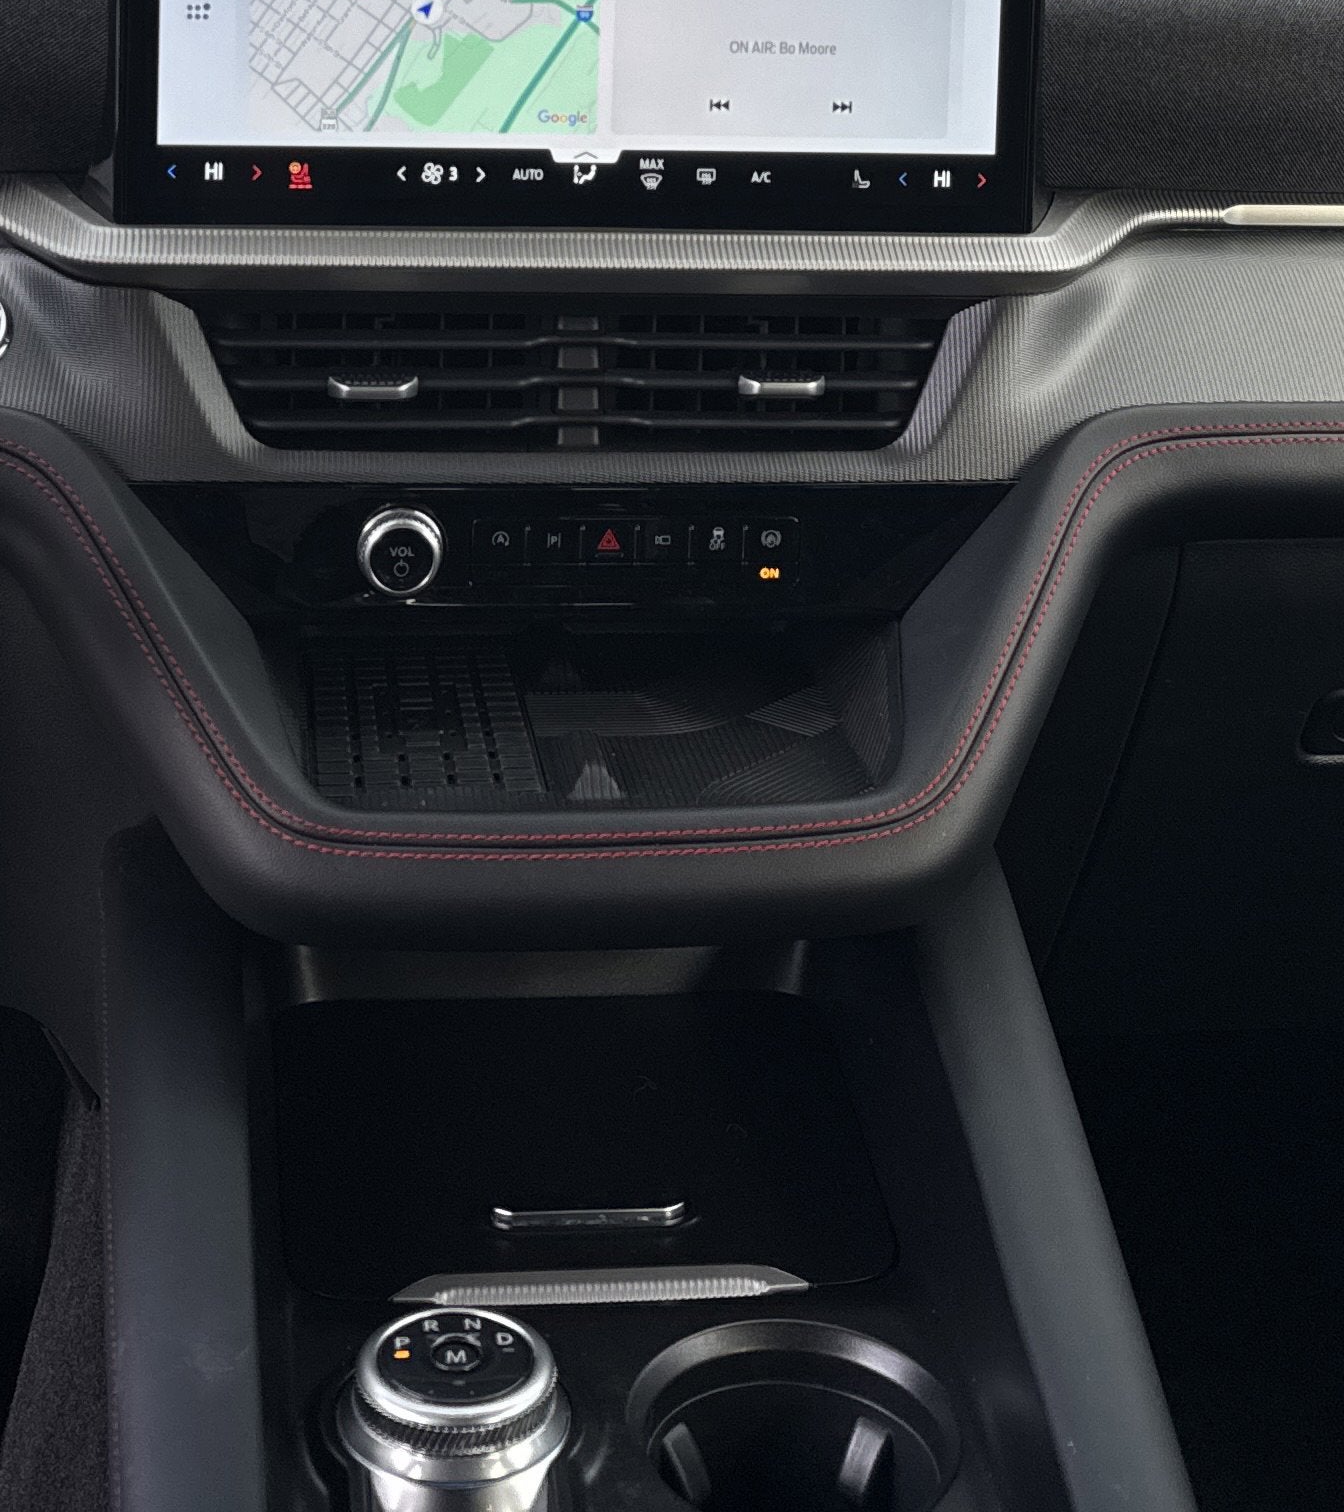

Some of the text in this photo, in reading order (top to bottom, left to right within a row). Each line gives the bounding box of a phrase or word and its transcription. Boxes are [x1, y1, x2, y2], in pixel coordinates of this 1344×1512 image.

[729, 40, 837, 56] ON AIR: Bo Moore
[537, 109, 588, 127] Google
[204, 162, 224, 181] HI
[638, 158, 665, 171] MAX
[448, 166, 458, 182] 3
[512, 167, 545, 183] AUTO
[750, 169, 772, 185] A/C
[932, 169, 952, 188] HI
[389, 545, 416, 558] VOL
[759, 567, 780, 580] ON
[422, 1317, 482, 1333] R N
[394, 1336, 411, 1350] P
[495, 1331, 515, 1347] D
[445, 1349, 467, 1365] M
